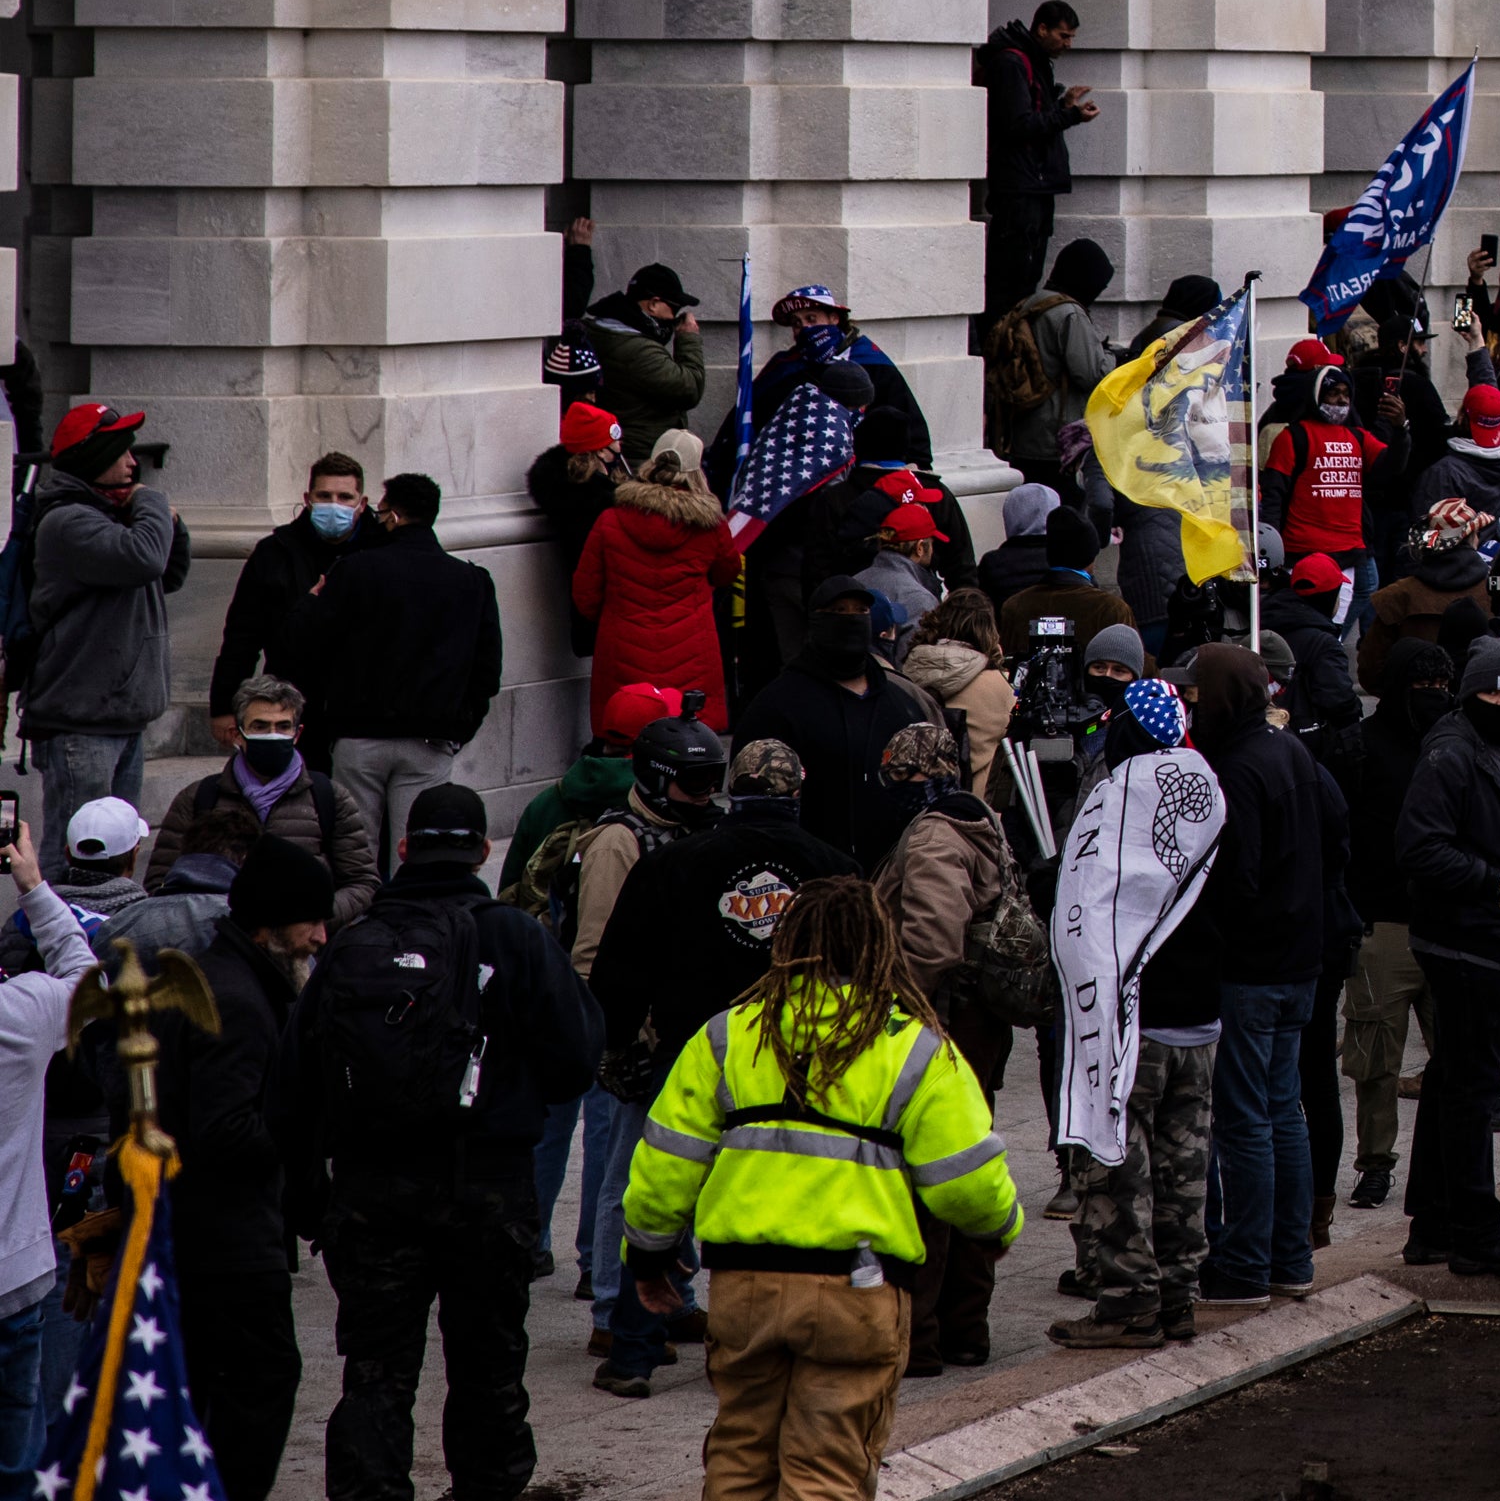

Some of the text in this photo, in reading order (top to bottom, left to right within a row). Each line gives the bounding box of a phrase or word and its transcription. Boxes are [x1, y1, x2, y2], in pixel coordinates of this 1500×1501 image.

[1324, 441, 1354, 454] KEEP
[1313, 456, 1363, 470] AMERICA
[1319, 488, 1348, 498] TRUMP
[649, 760, 678, 777] SMITH
[748, 883, 780, 897] SUPER
[1067, 903, 1083, 939] or
